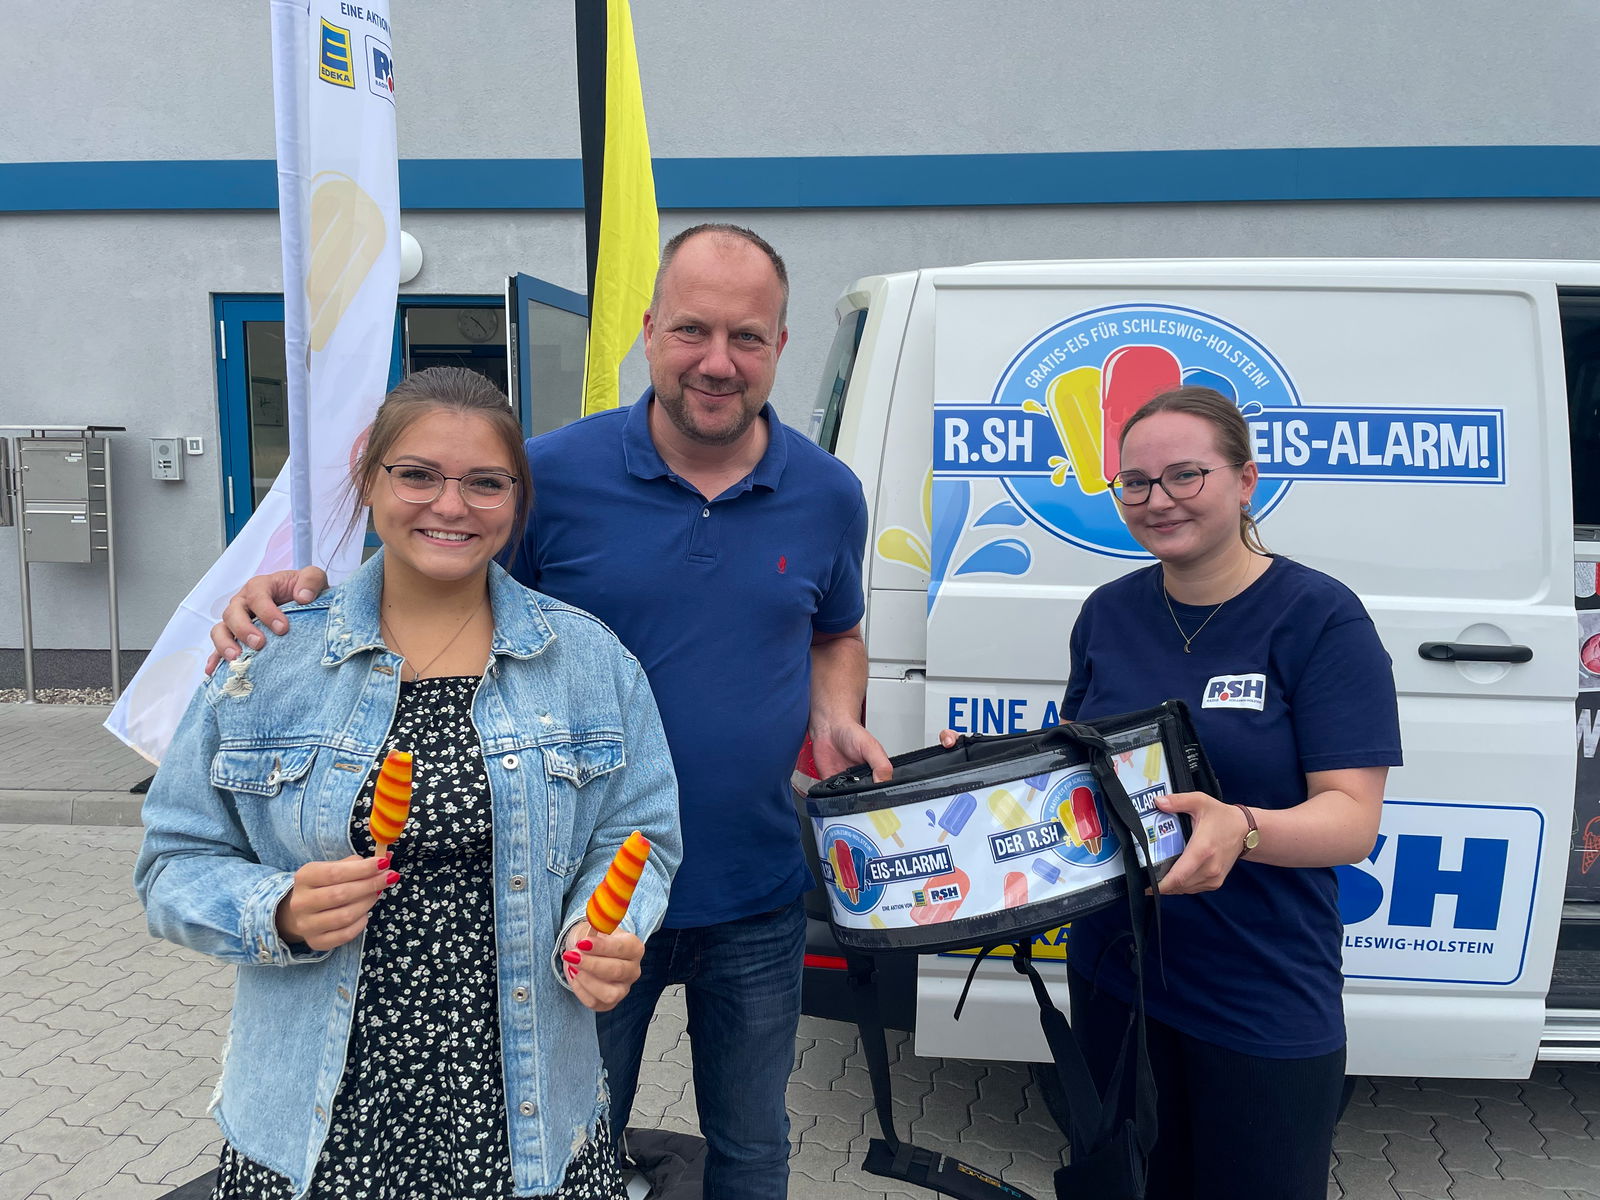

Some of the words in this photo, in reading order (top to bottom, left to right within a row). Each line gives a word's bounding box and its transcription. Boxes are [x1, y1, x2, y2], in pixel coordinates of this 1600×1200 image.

[341, 2, 364, 19] EINE
[321, 66, 351, 83] EDEKA
[1025, 333, 1090, 389] GRATIS-EIS
[1090, 322, 1120, 343] FÜR
[1122, 318, 1271, 390] SCHLESWIG-HOLSTEIN!
[944, 417, 1033, 464] R.SH
[1253, 419, 1490, 470] EIS-ALARM!
[949, 697, 1027, 734] EINE
[995, 834, 1024, 856] DER
[1027, 824, 1059, 848] R.SH
[870, 852, 949, 880] EIS-ALARM!
[1345, 936, 1494, 954] LESWIG-HOLSTEIN
